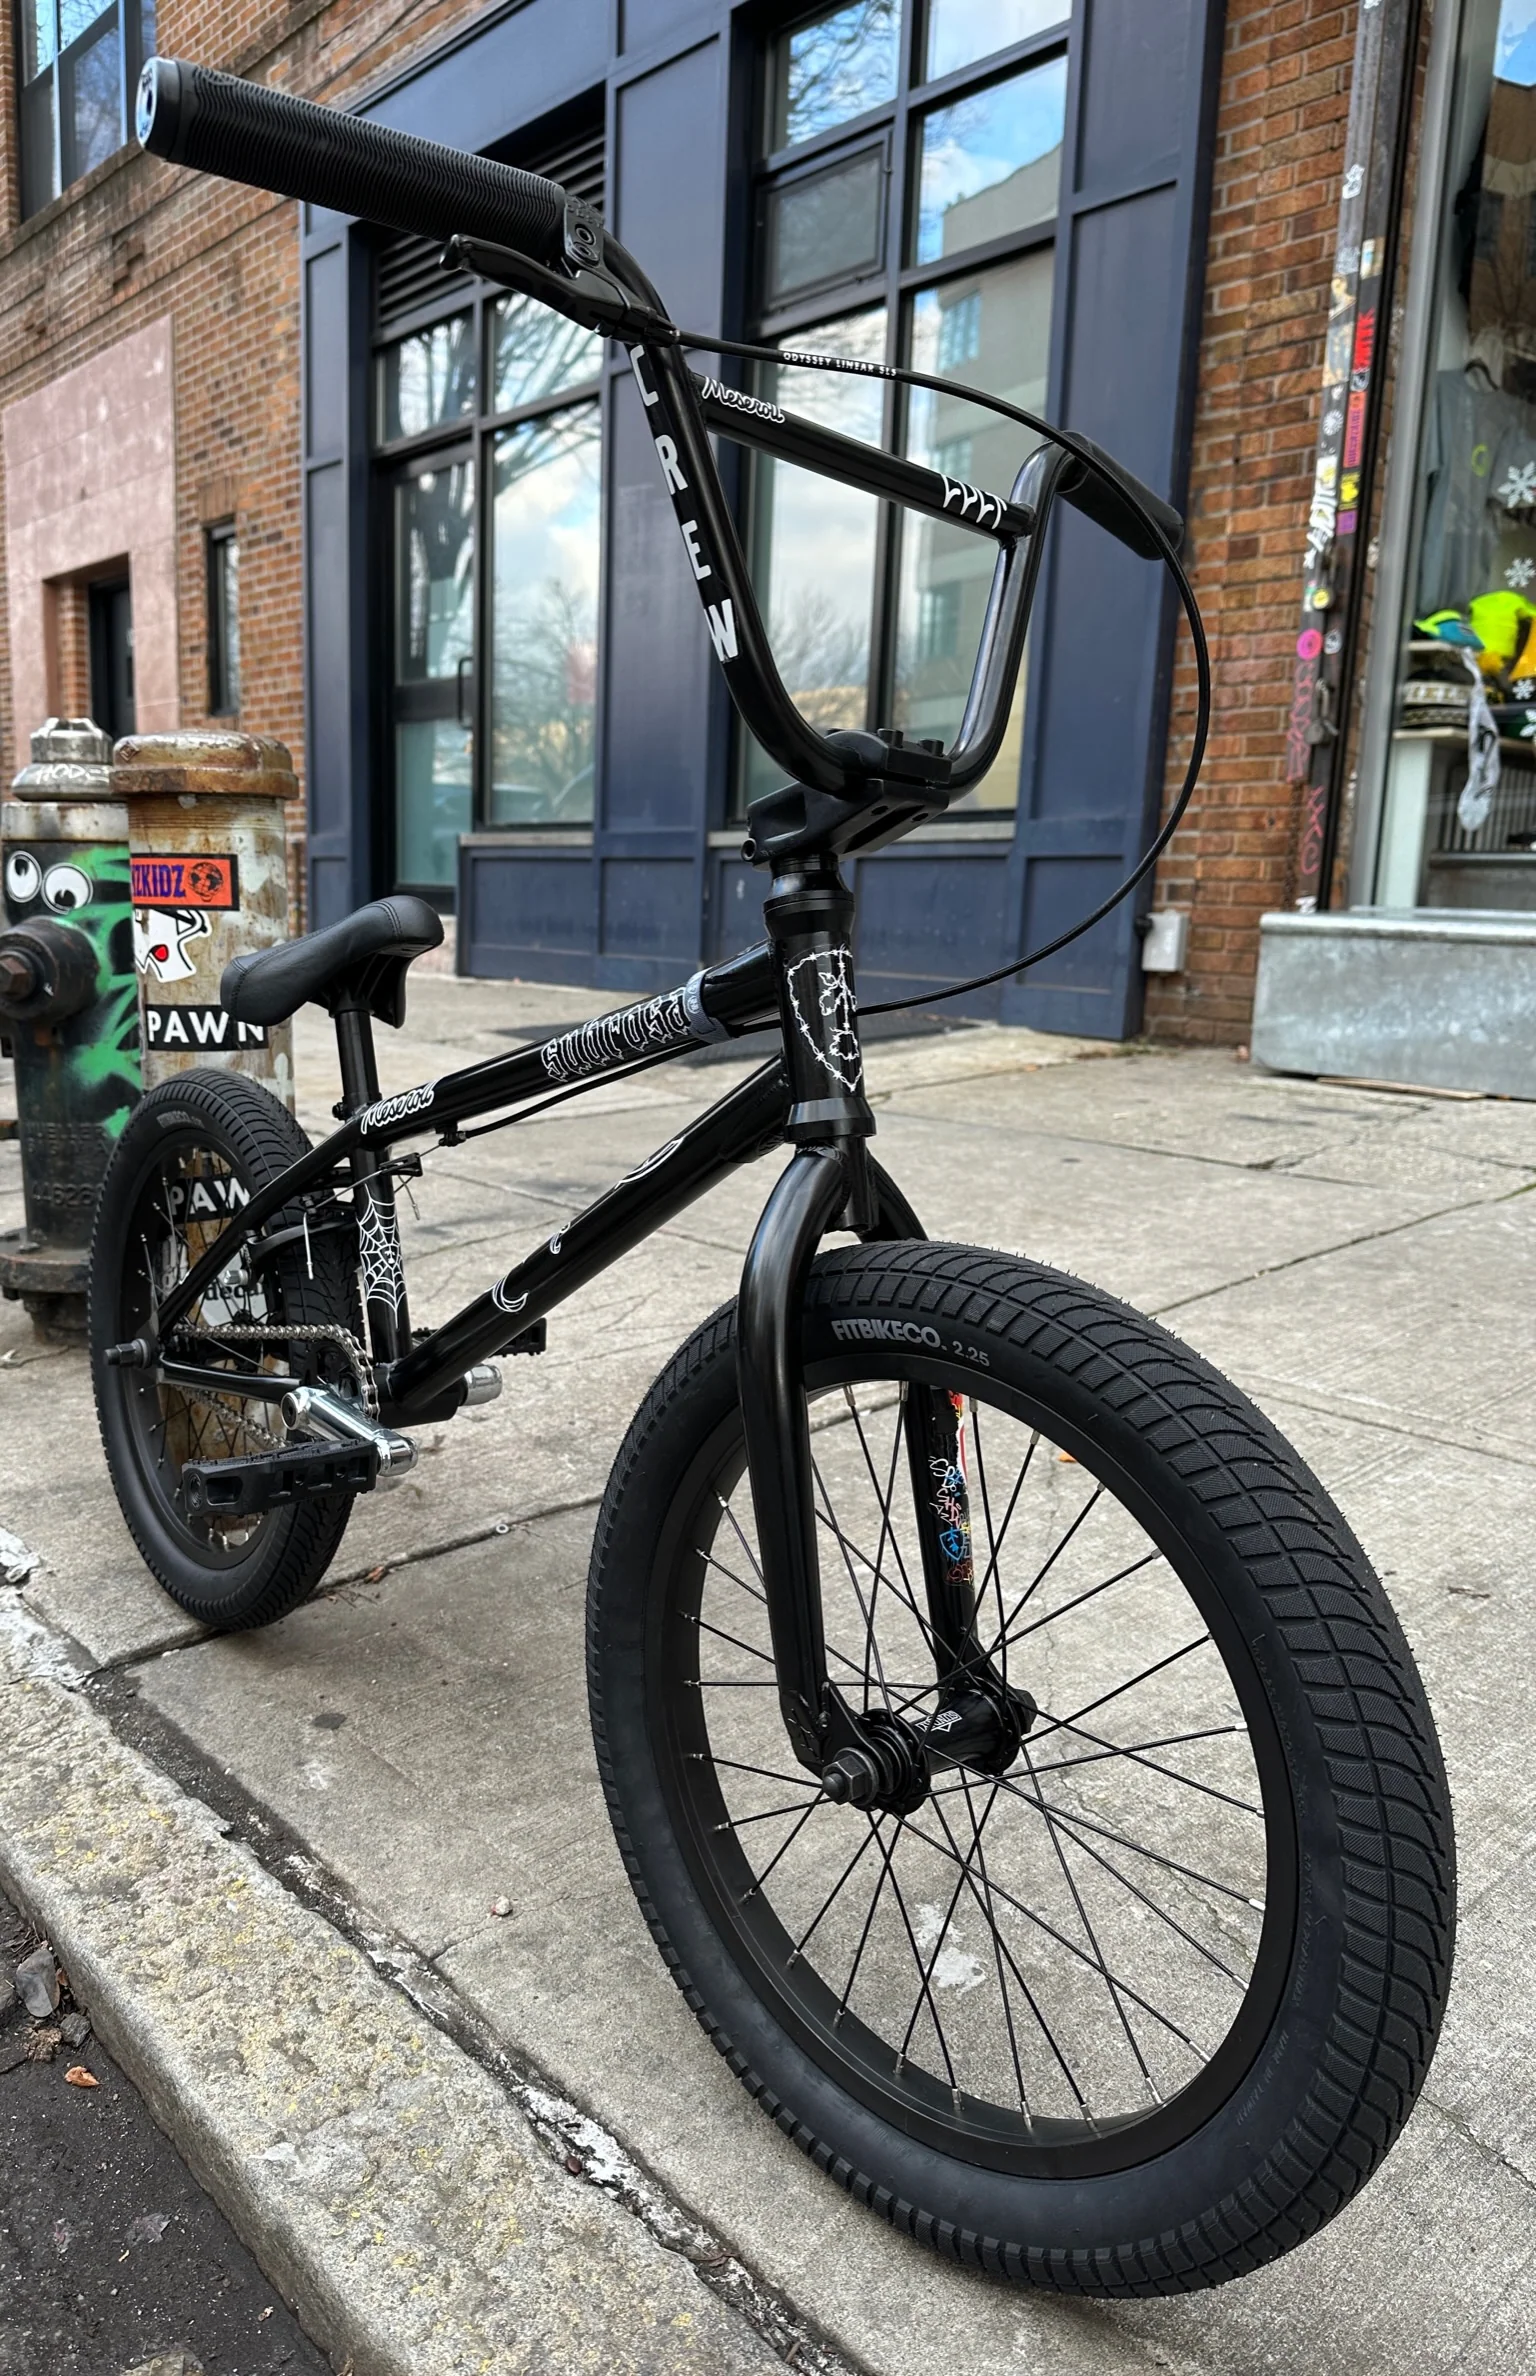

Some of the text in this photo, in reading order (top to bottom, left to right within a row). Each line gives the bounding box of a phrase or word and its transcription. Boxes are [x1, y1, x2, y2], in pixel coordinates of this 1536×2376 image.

[783, 352, 831, 366] ODYSSEY
[836, 359, 874, 372] LINEAR
[131, 864, 186, 897] ZKIDZ
[147, 1010, 264, 1043] PAWN
[170, 1177, 251, 1215] PAW
[953, 1341, 990, 1367] 2.25
